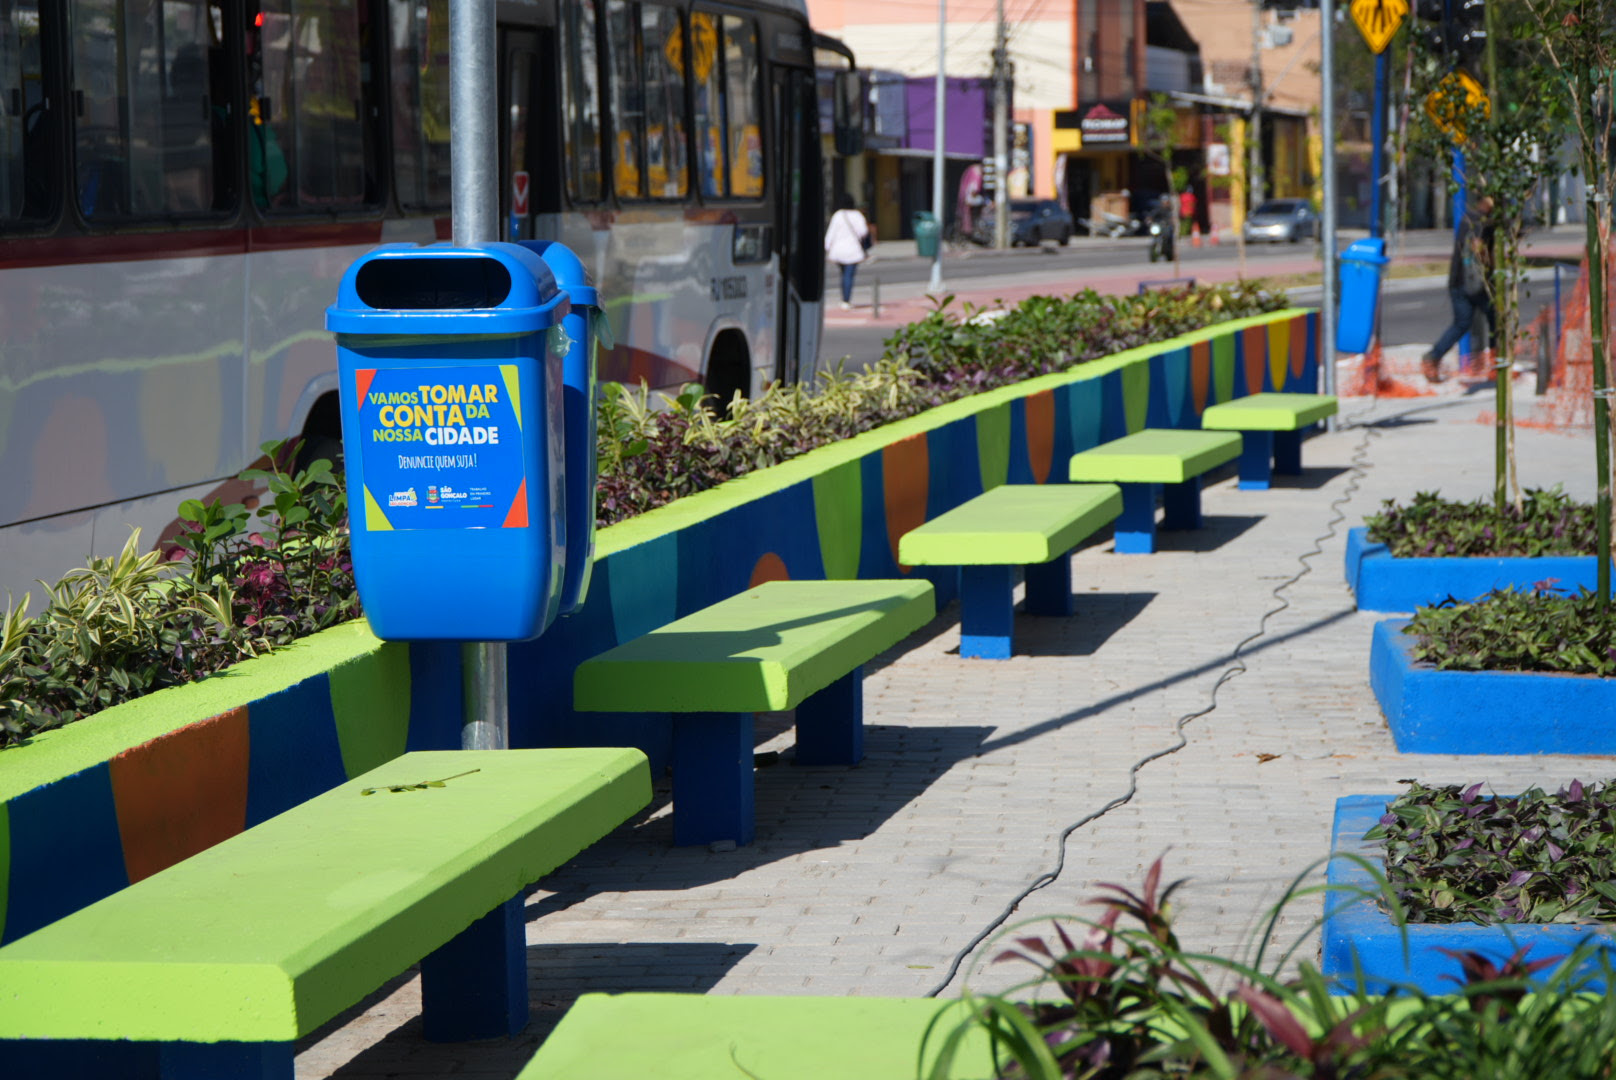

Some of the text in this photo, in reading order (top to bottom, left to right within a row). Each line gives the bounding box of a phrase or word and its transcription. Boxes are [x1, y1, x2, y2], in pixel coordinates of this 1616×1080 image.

[368, 384, 499, 404] VAMOS TOMAR
[379, 404, 490, 427] CONTA DA
[373, 426, 499, 445] NOSSA CIDADE
[398, 454, 434, 469] DENUNCIE
[435, 455, 456, 471] QUEM
[440, 485, 452, 493] SÃO
